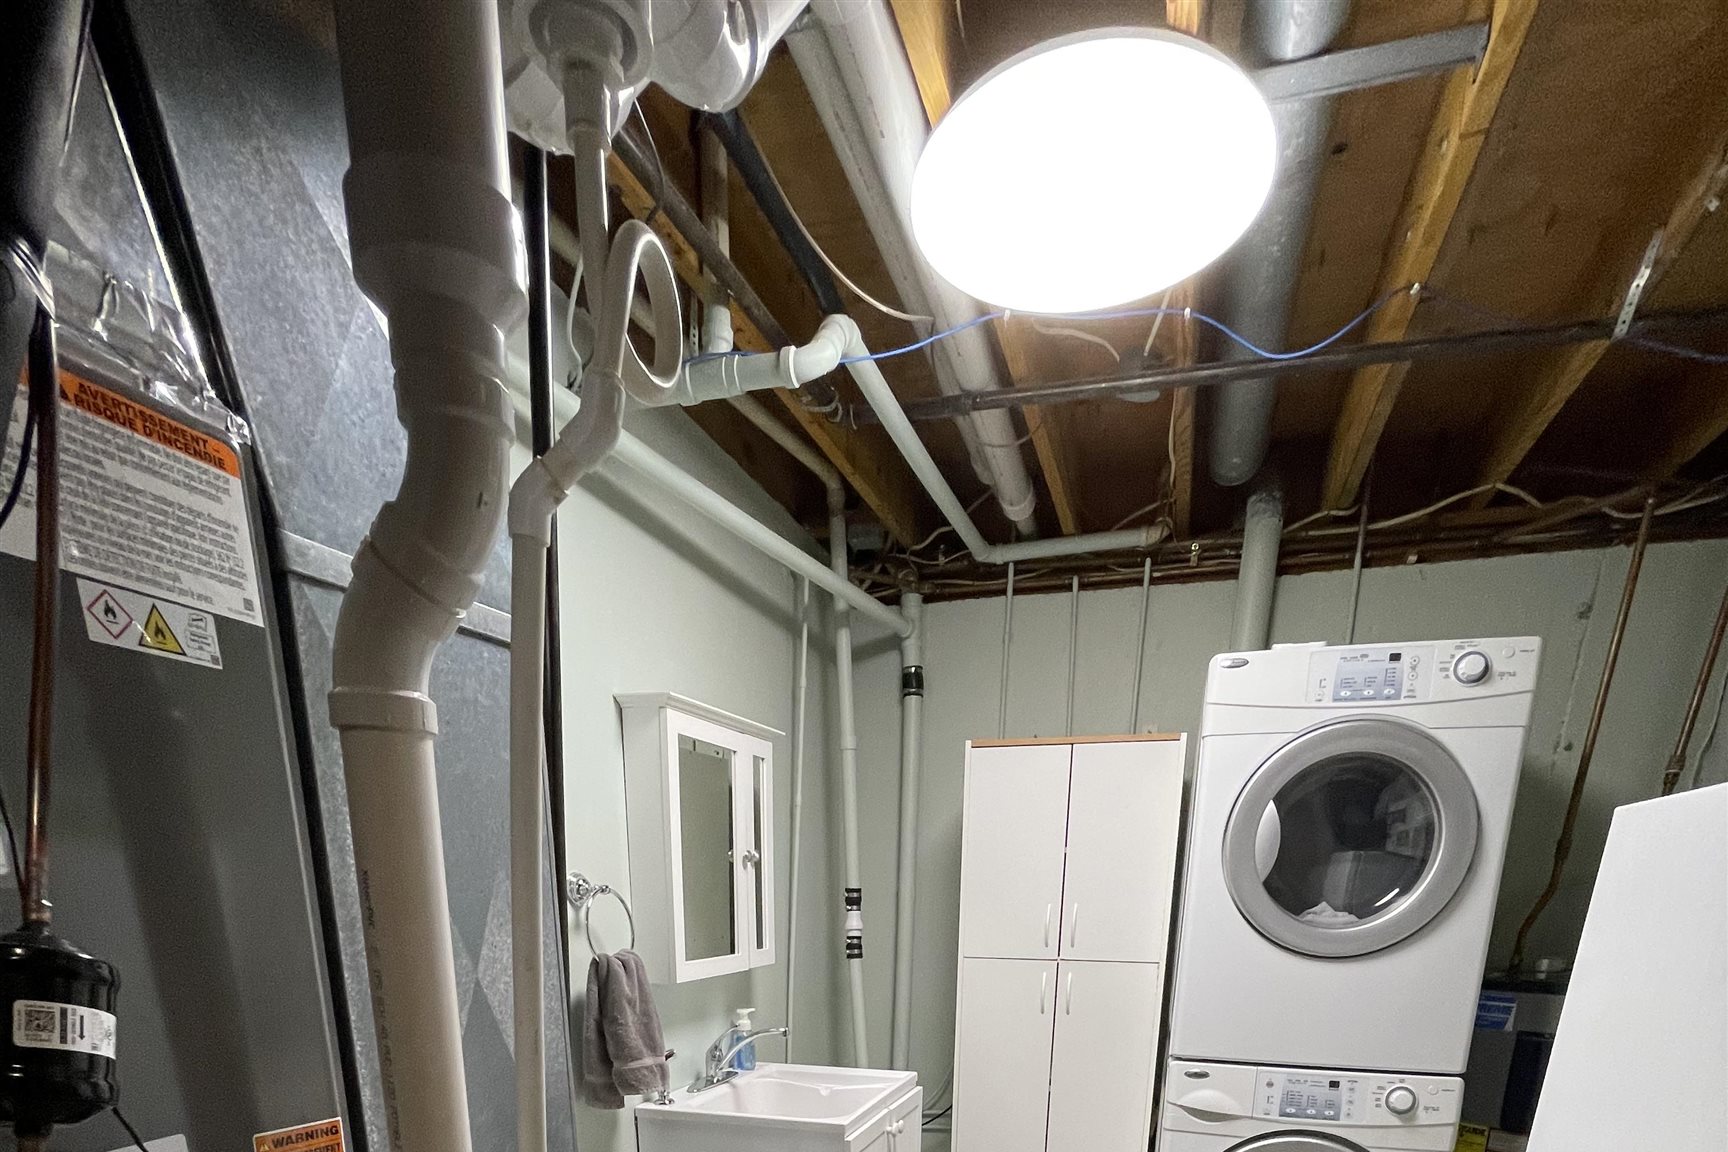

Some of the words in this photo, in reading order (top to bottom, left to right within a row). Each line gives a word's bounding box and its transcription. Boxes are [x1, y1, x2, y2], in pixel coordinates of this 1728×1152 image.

[74, 393, 138, 433] RISQUE
[79, 382, 209, 448] AVERTISSEMENT
[271, 1125, 339, 1148] WARNING
